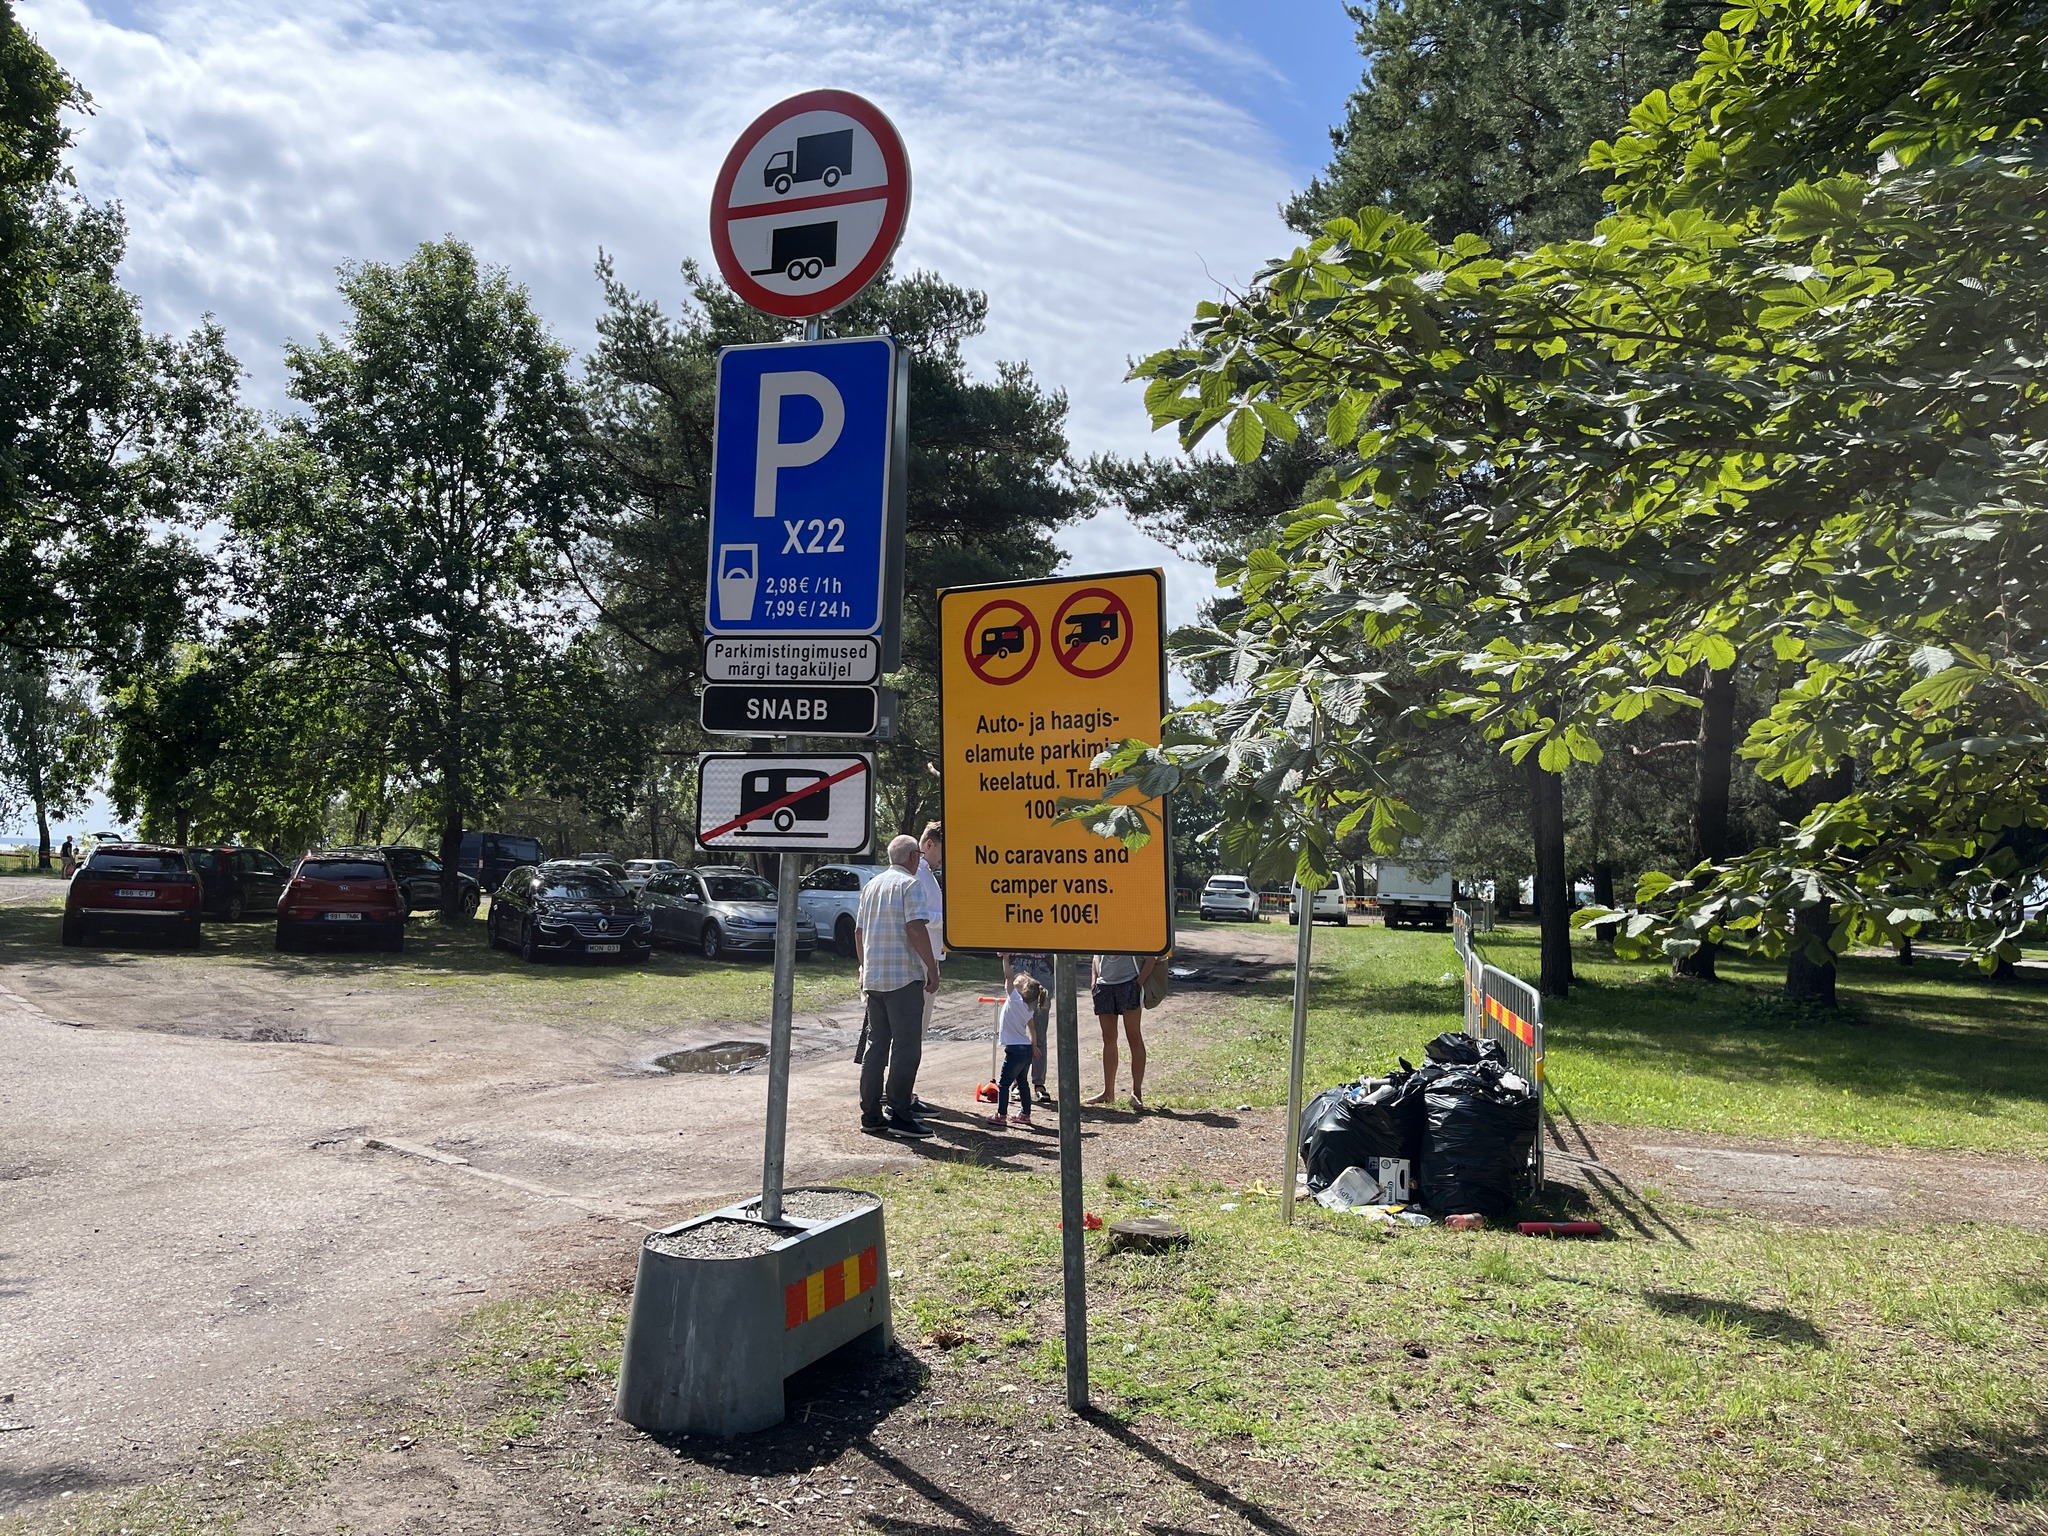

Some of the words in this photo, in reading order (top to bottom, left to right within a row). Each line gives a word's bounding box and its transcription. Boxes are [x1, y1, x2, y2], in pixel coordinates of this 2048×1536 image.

[753, 370, 846, 518] P
[781, 518, 845, 554] X22
[714, 643, 868, 662] Parkimistingimused
[728, 661, 770, 679] märgi
[775, 661, 852, 680] tagaküljel
[746, 698, 828, 720] SNABB
[976, 714, 1024, 734] Auto-
[1028, 711, 1045, 736] ja
[1051, 708, 1120, 733] haagis-
[965, 743, 1035, 763] elamute
[979, 770, 1061, 791] keelatud.
[975, 845, 999, 864] No
[1005, 848, 1088, 864] caravans
[1094, 845, 1129, 863] and
[990, 878, 1058, 898] camper
[1063, 878, 1113, 894] vans.
[1005, 904, 1044, 923] Fine
[1050, 903, 1099, 924] 100€!
